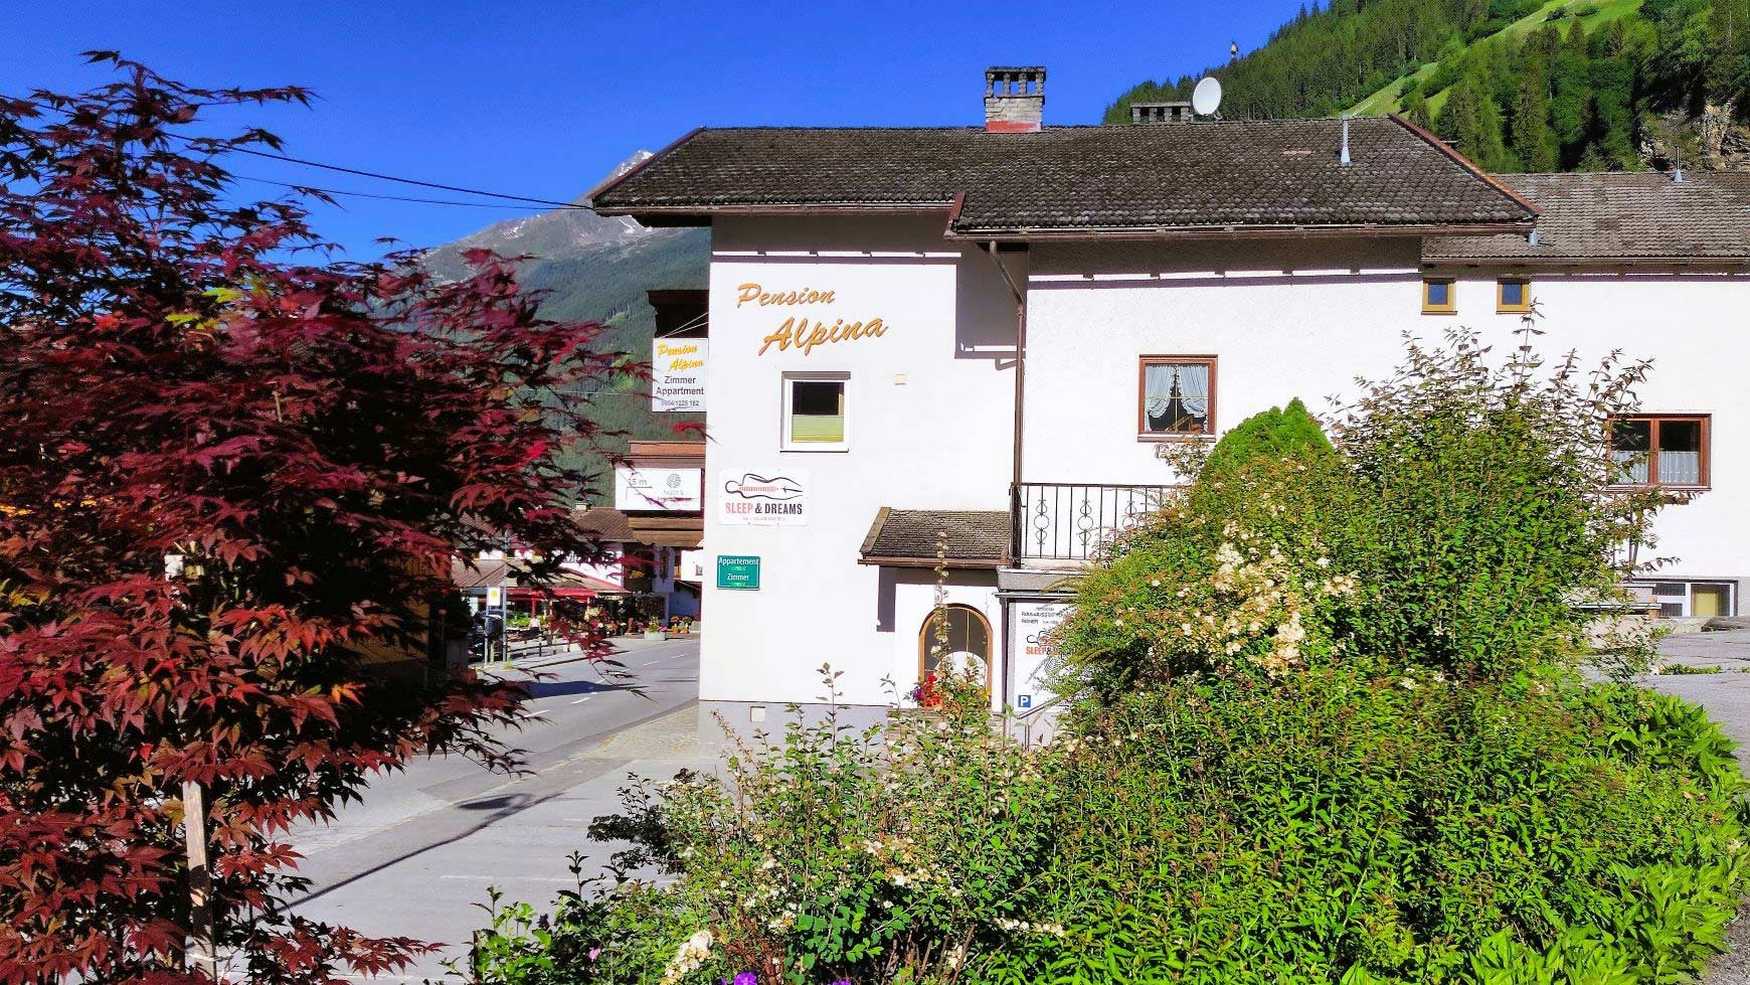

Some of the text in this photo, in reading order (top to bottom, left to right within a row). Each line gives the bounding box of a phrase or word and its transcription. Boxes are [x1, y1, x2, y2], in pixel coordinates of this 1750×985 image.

[737, 282, 835, 308] Pension
[758, 316, 889, 356] Alpina
[656, 341, 698, 357] Pension
[668, 358, 704, 373] Alpina
[664, 375, 696, 384] Zimmer
[656, 386, 704, 397] Appartment
[725, 502, 803, 515] SLEEP & DREAMS
[727, 573, 749, 581] Zimmer
